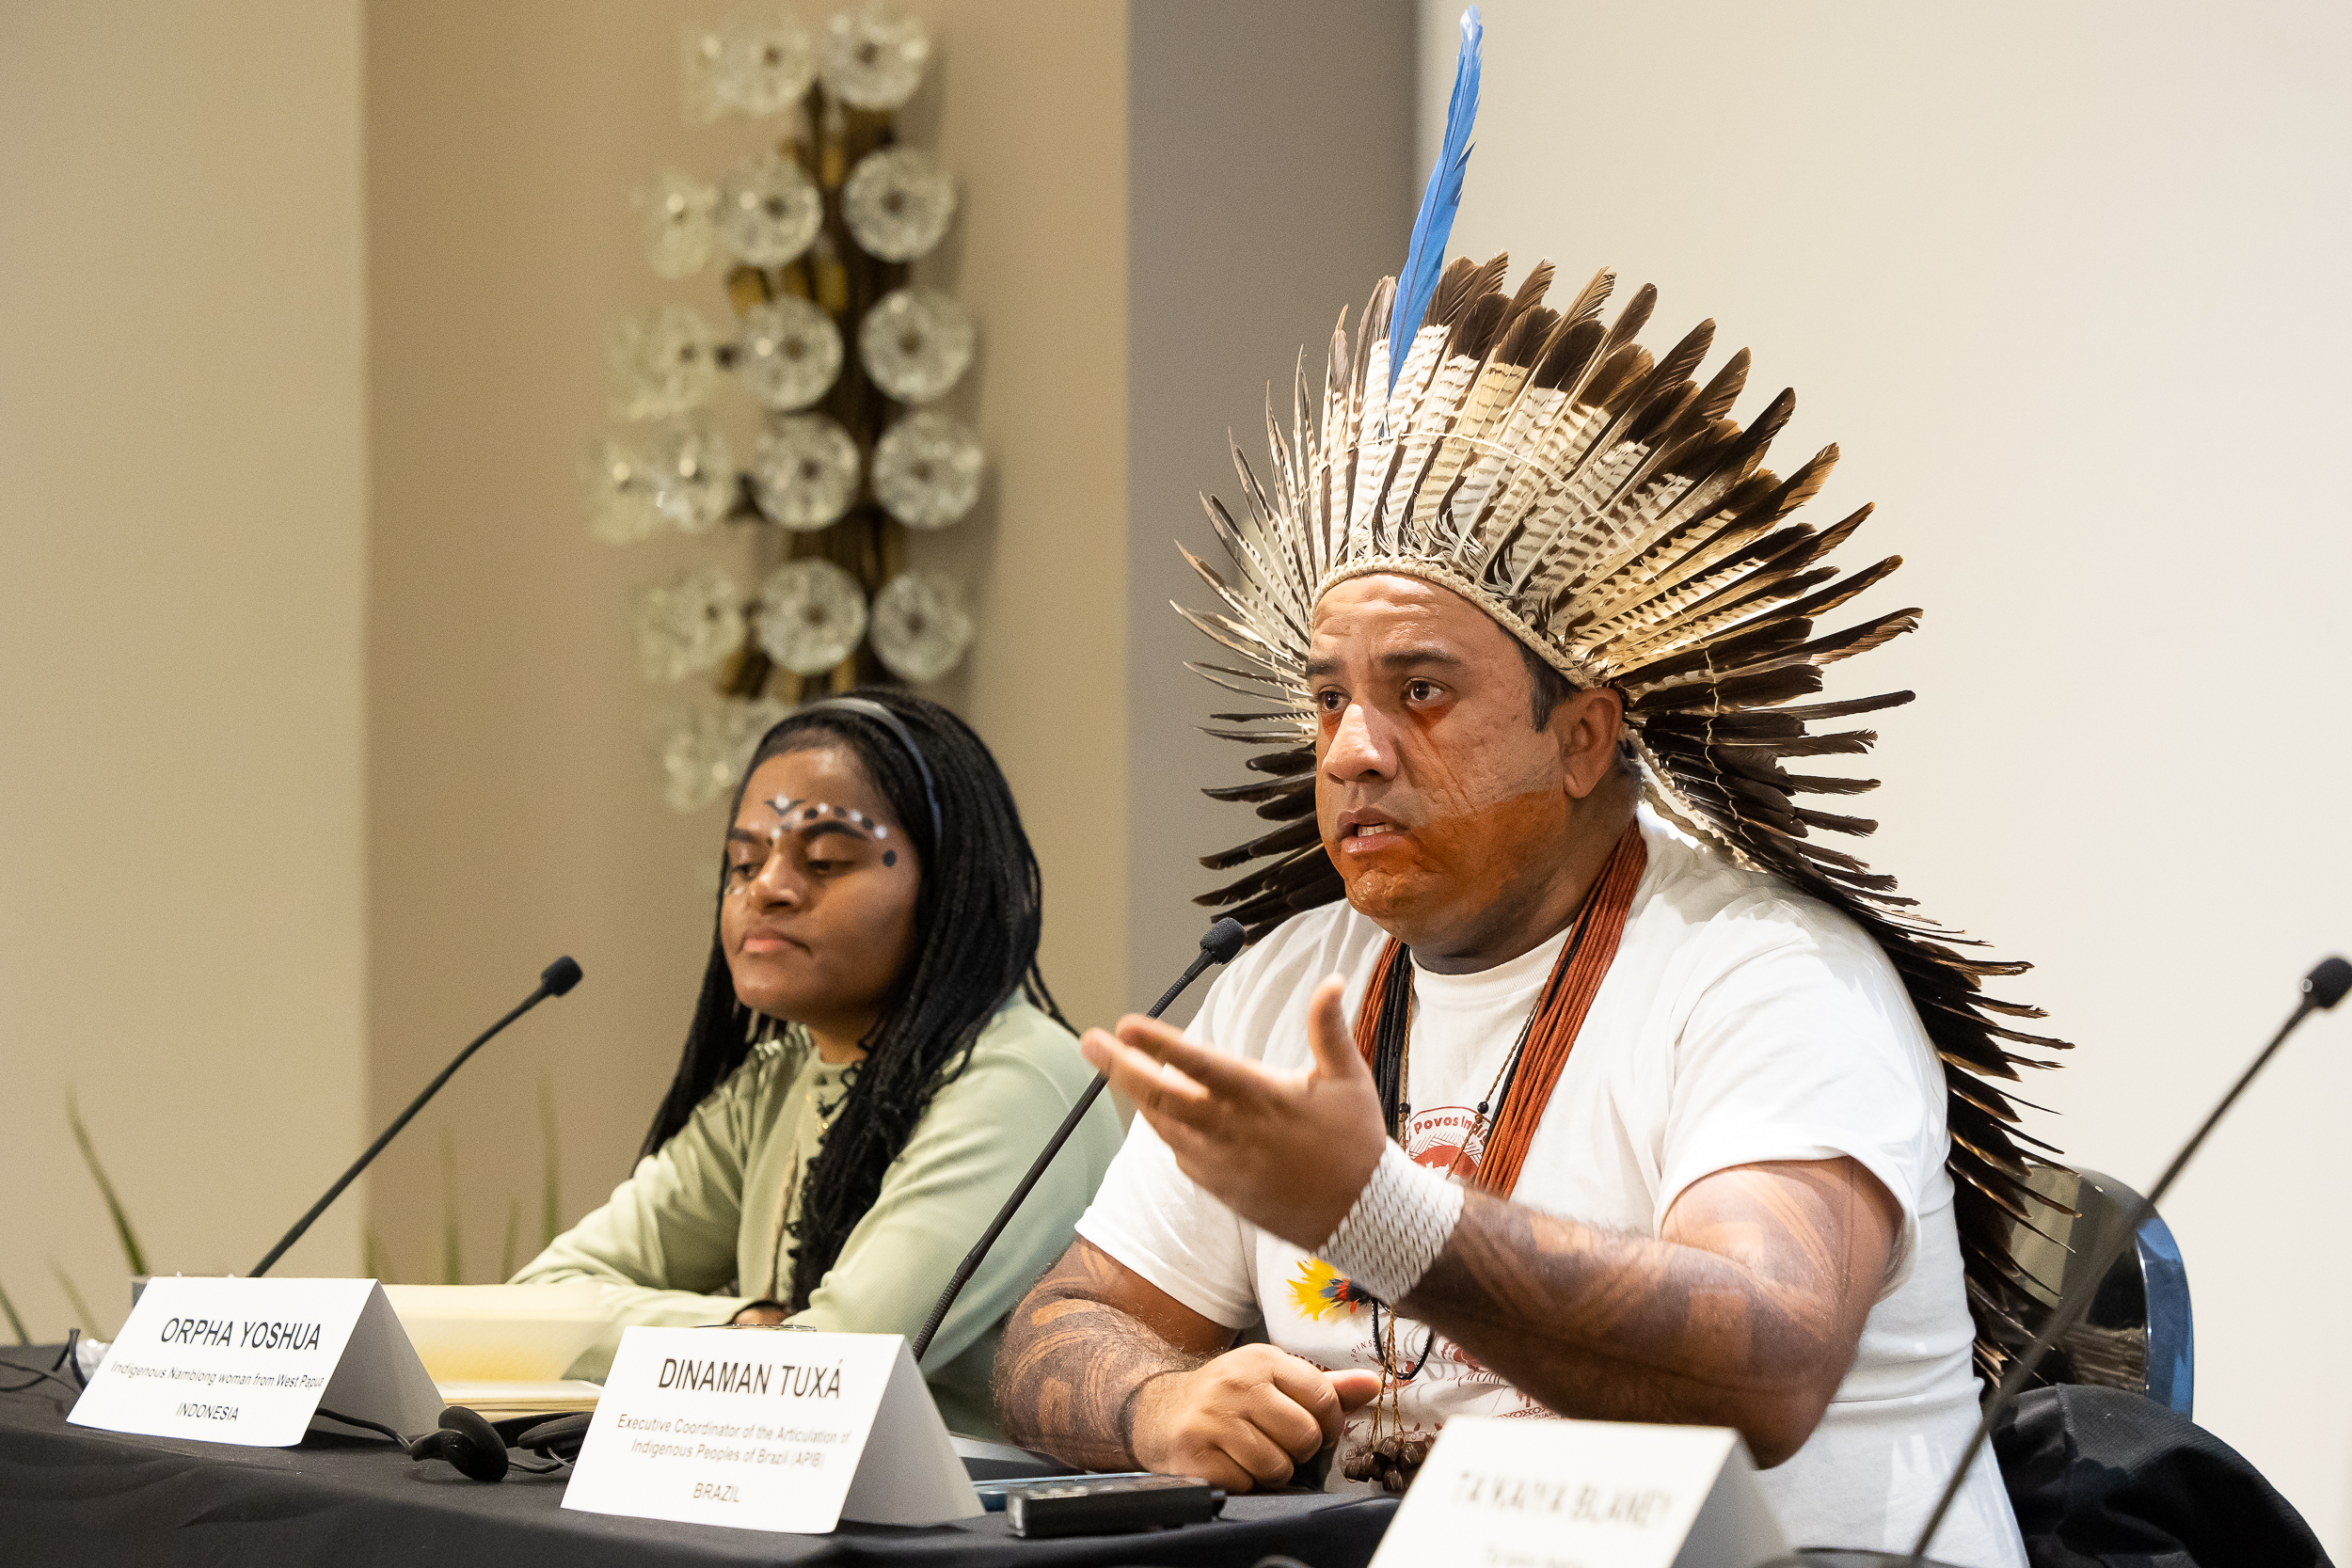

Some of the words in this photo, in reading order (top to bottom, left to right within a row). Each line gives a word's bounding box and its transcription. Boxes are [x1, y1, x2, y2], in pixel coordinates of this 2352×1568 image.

[161, 1318, 233, 1346] ORPHA
[240, 1322, 321, 1350] YOSHUA
[111, 1361, 167, 1379] Indigenous
[167, 1368, 216, 1386] Namblong
[218, 1374, 252, 1386] woman
[253, 1372, 275, 1386] from
[276, 1374, 299, 1387] West
[299, 1375, 324, 1390] Papua
[659, 1358, 771, 1395] DINAMAN
[781, 1358, 843, 1400] TUXÁ
[176, 1402, 239, 1421] INDONESIA
[617, 1414, 672, 1433] Executive
[675, 1418, 741, 1437] Coordinator
[742, 1424, 756, 1438] of
[756, 1425, 774, 1440] the
[775, 1426, 837, 1444] Articulation
[631, 1438, 693, 1458] Indigenous
[696, 1444, 739, 1463] Peoples
[743, 1449, 756, 1463] of
[756, 1449, 789, 1465] Brazil
[692, 1482, 740, 1503] BRAZIL
